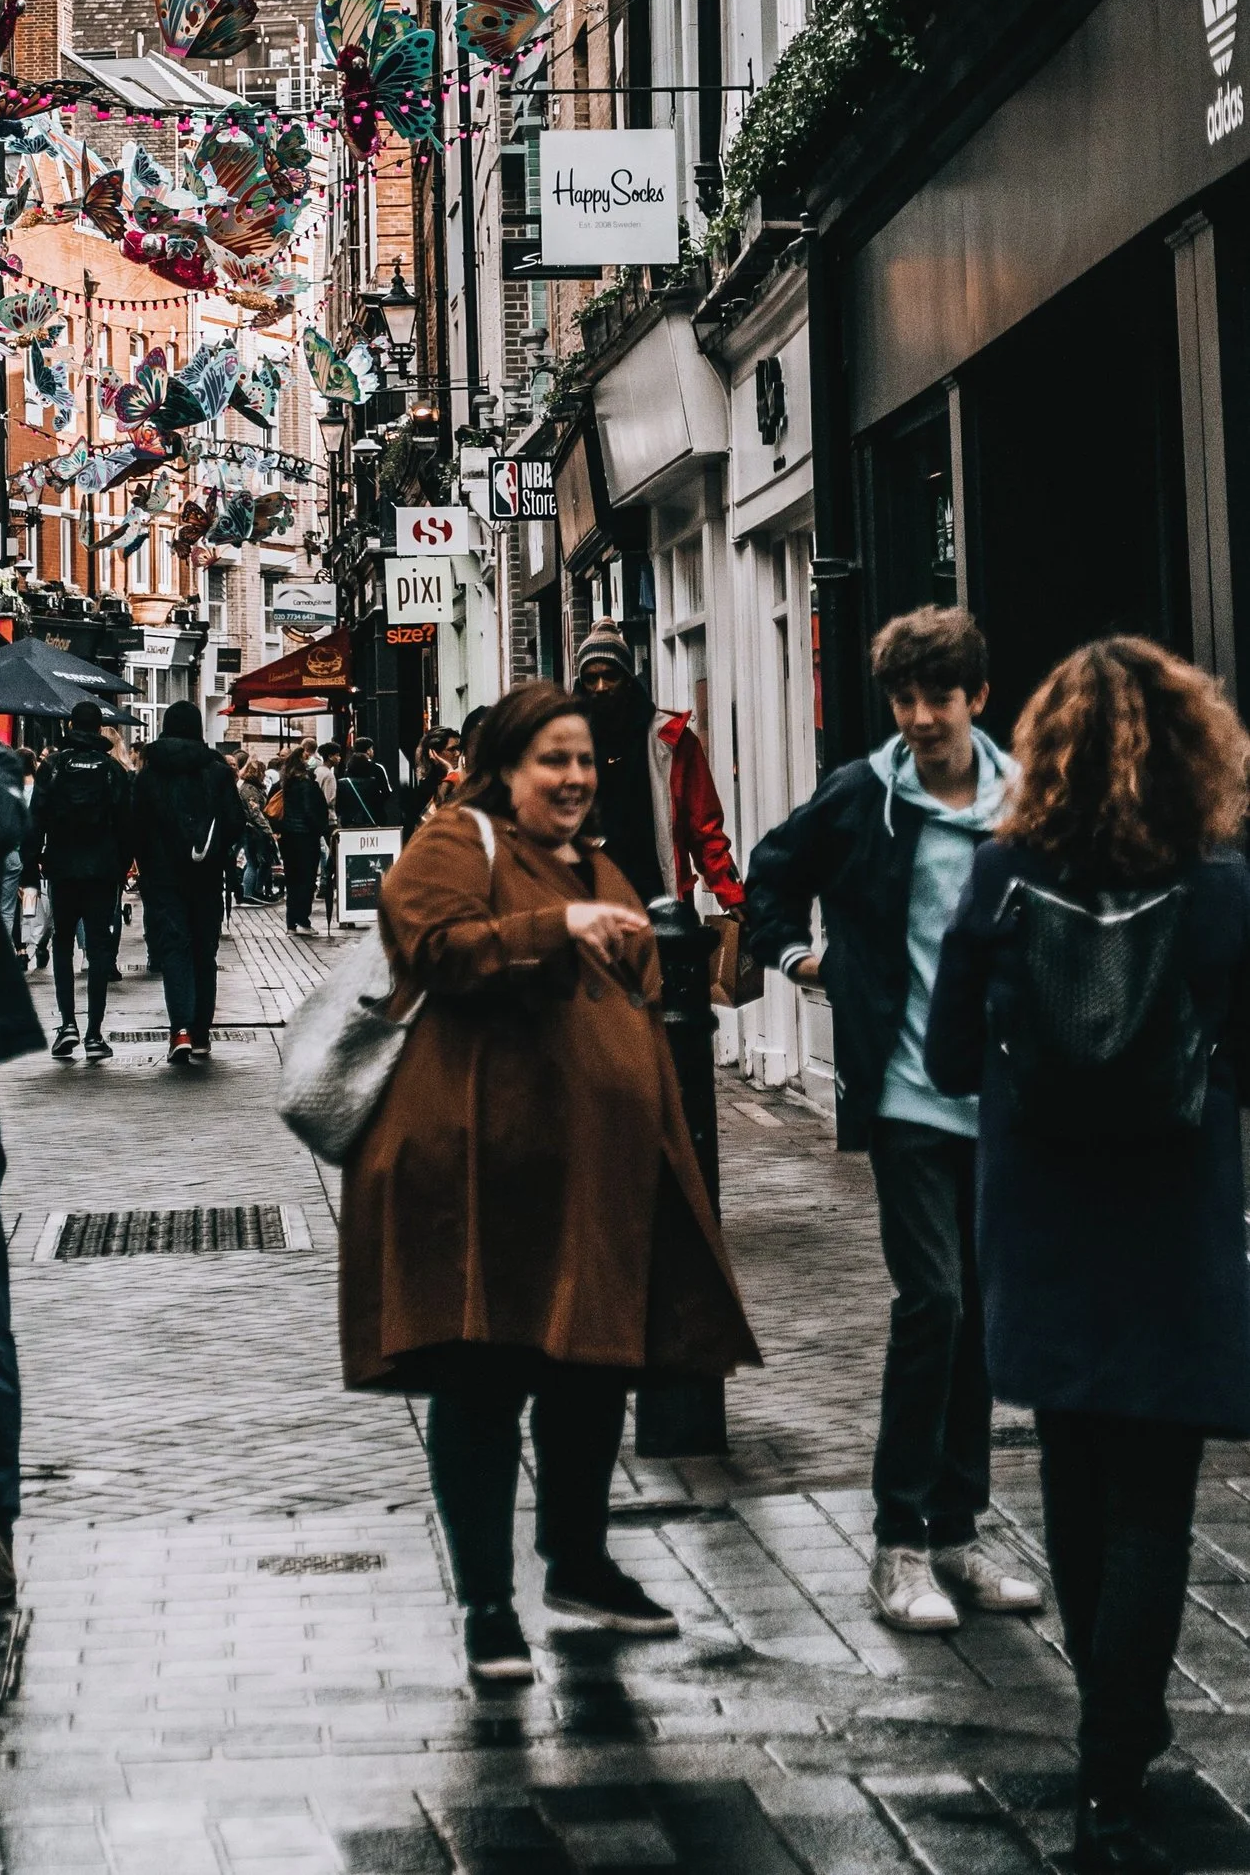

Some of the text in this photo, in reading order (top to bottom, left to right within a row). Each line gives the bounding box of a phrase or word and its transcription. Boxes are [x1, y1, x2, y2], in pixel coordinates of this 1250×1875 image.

[1206, 80, 1244, 146] adidas
[552, 167, 665, 213] Happy Socks
[578, 221, 641, 229] Est. 2008 Sweden
[521, 461, 553, 489] NBA
[522, 489, 558, 516] Store
[386, 624, 435, 644] size?
